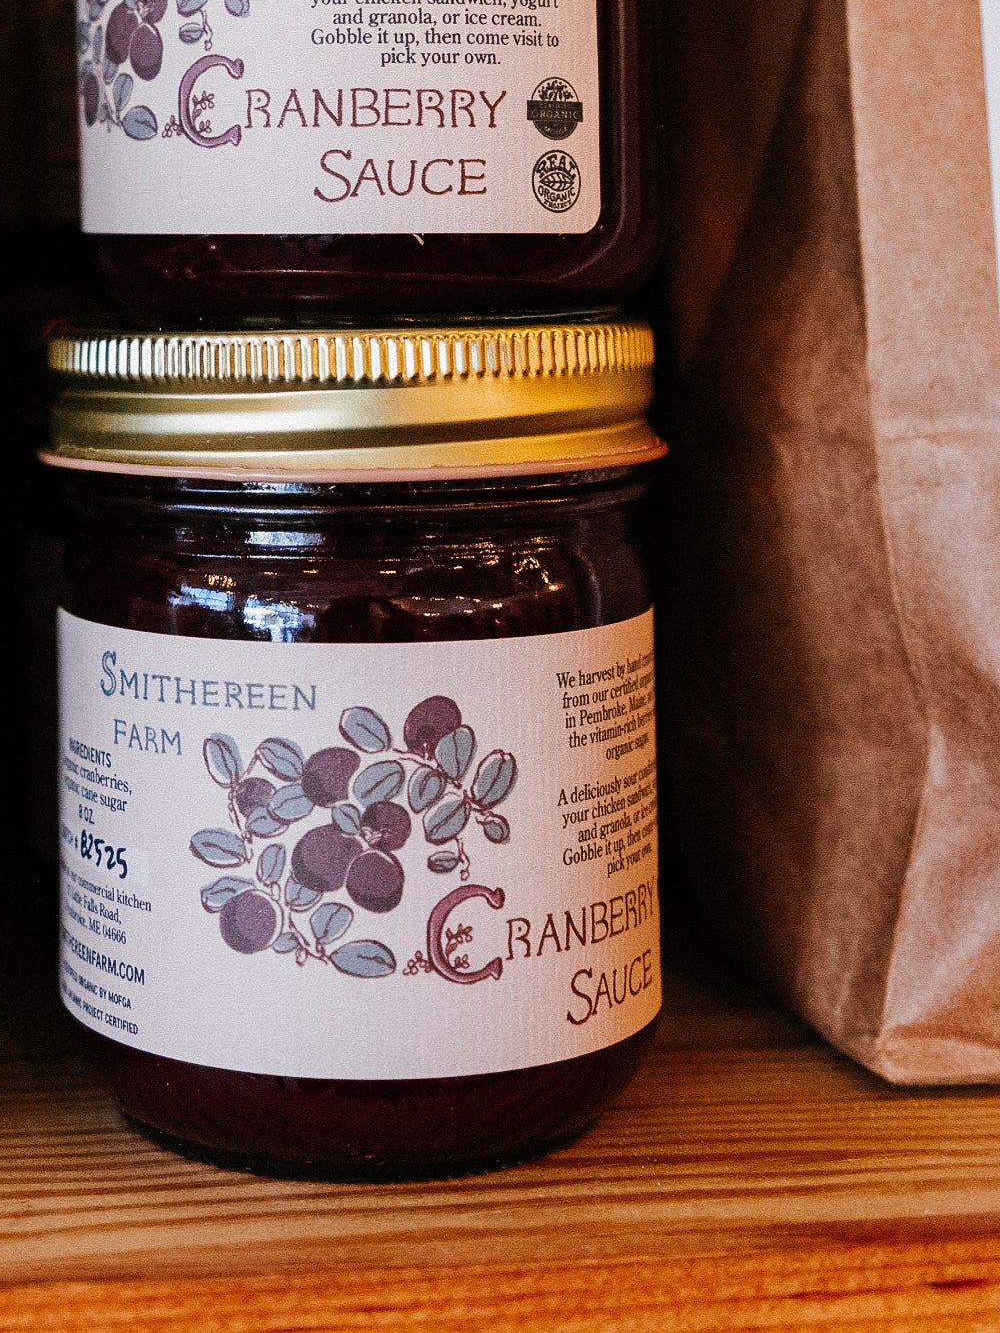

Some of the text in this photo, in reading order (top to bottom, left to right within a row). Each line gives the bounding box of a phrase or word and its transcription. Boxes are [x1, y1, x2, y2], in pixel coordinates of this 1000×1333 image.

[332, 8, 542, 27] and granola, or ice cream.
[311, 28, 559, 48] Gobble it up, then come visit to
[380, 48, 501, 67] pick your own.
[178, 54, 507, 149] CRANBERRY
[313, 149, 487, 204] SAUCE
[536, 154, 577, 179] REAL
[537, 185, 576, 202] ORGANIC
[100, 650, 318, 711] SMITHEREEN
[556, 666, 615, 689] We harvest
[562, 686, 609, 709] from our
[113, 718, 183, 756] FARM
[79, 767, 132, 796] cranberries,
[557, 775, 622, 807] A deliciously
[81, 786, 128, 812] cane sugar
[562, 795, 626, 830] your chicken
[563, 842, 603, 867] Gobble
[83, 894, 122, 925] Falls Road,
[116, 889, 152, 912] kitchen
[88, 916, 127, 945] ME 04666
[426, 876, 655, 985] CRANBERRY
[566, 949, 653, 1026] SAUCE
[104, 1012, 139, 1035] CERTIFIED
